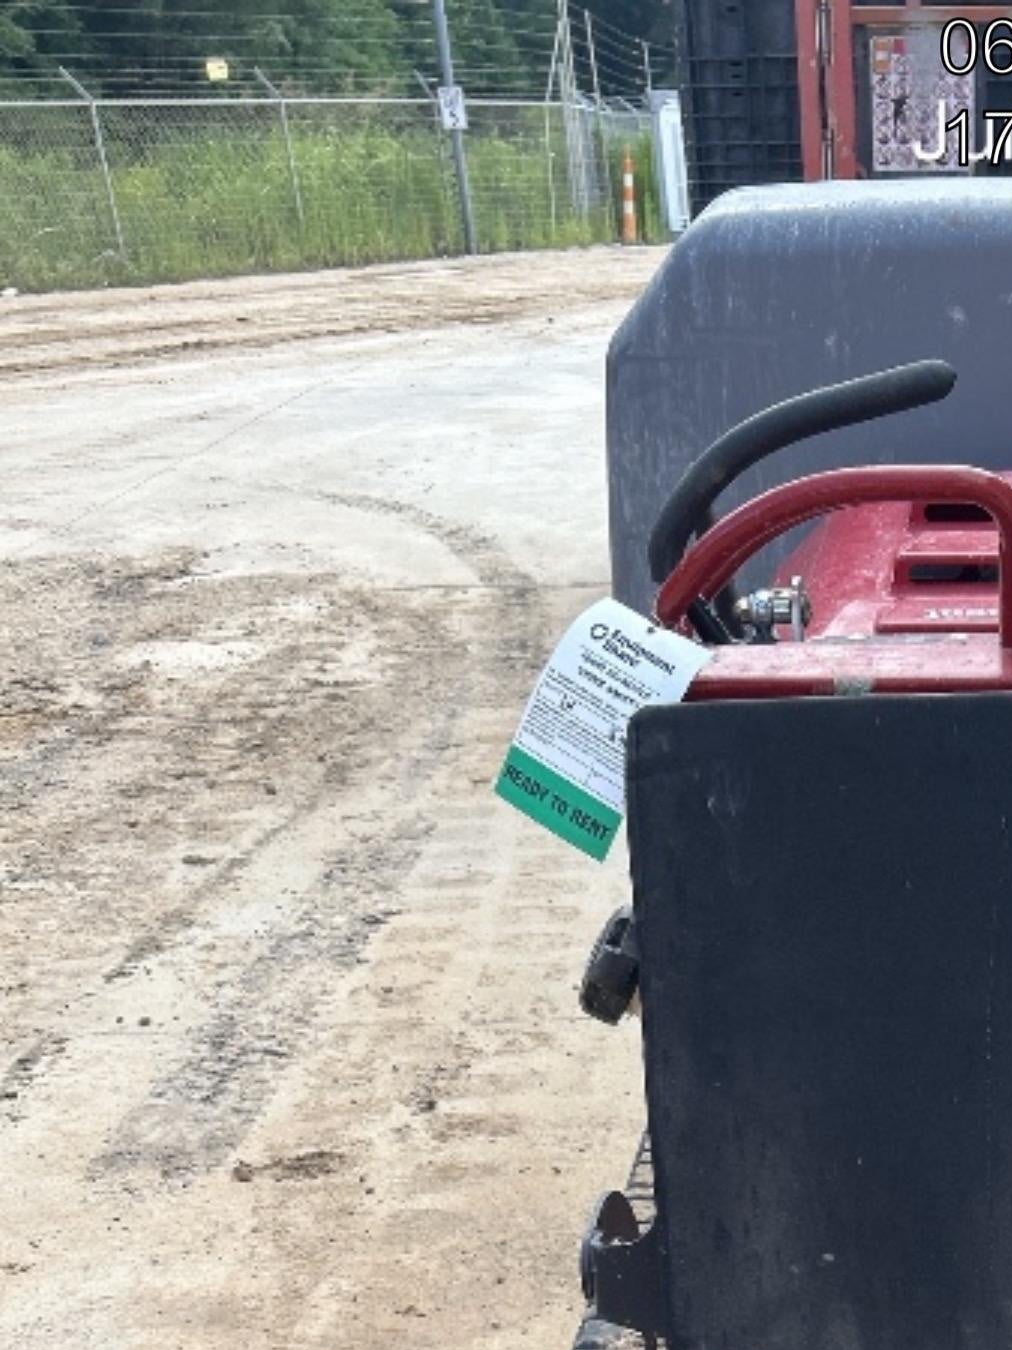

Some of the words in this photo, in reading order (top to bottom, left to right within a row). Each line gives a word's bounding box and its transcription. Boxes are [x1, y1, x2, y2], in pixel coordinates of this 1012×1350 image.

[502, 764, 550, 802] READY
[550, 794, 568, 817] TO
[569, 808, 611, 840] RENT
